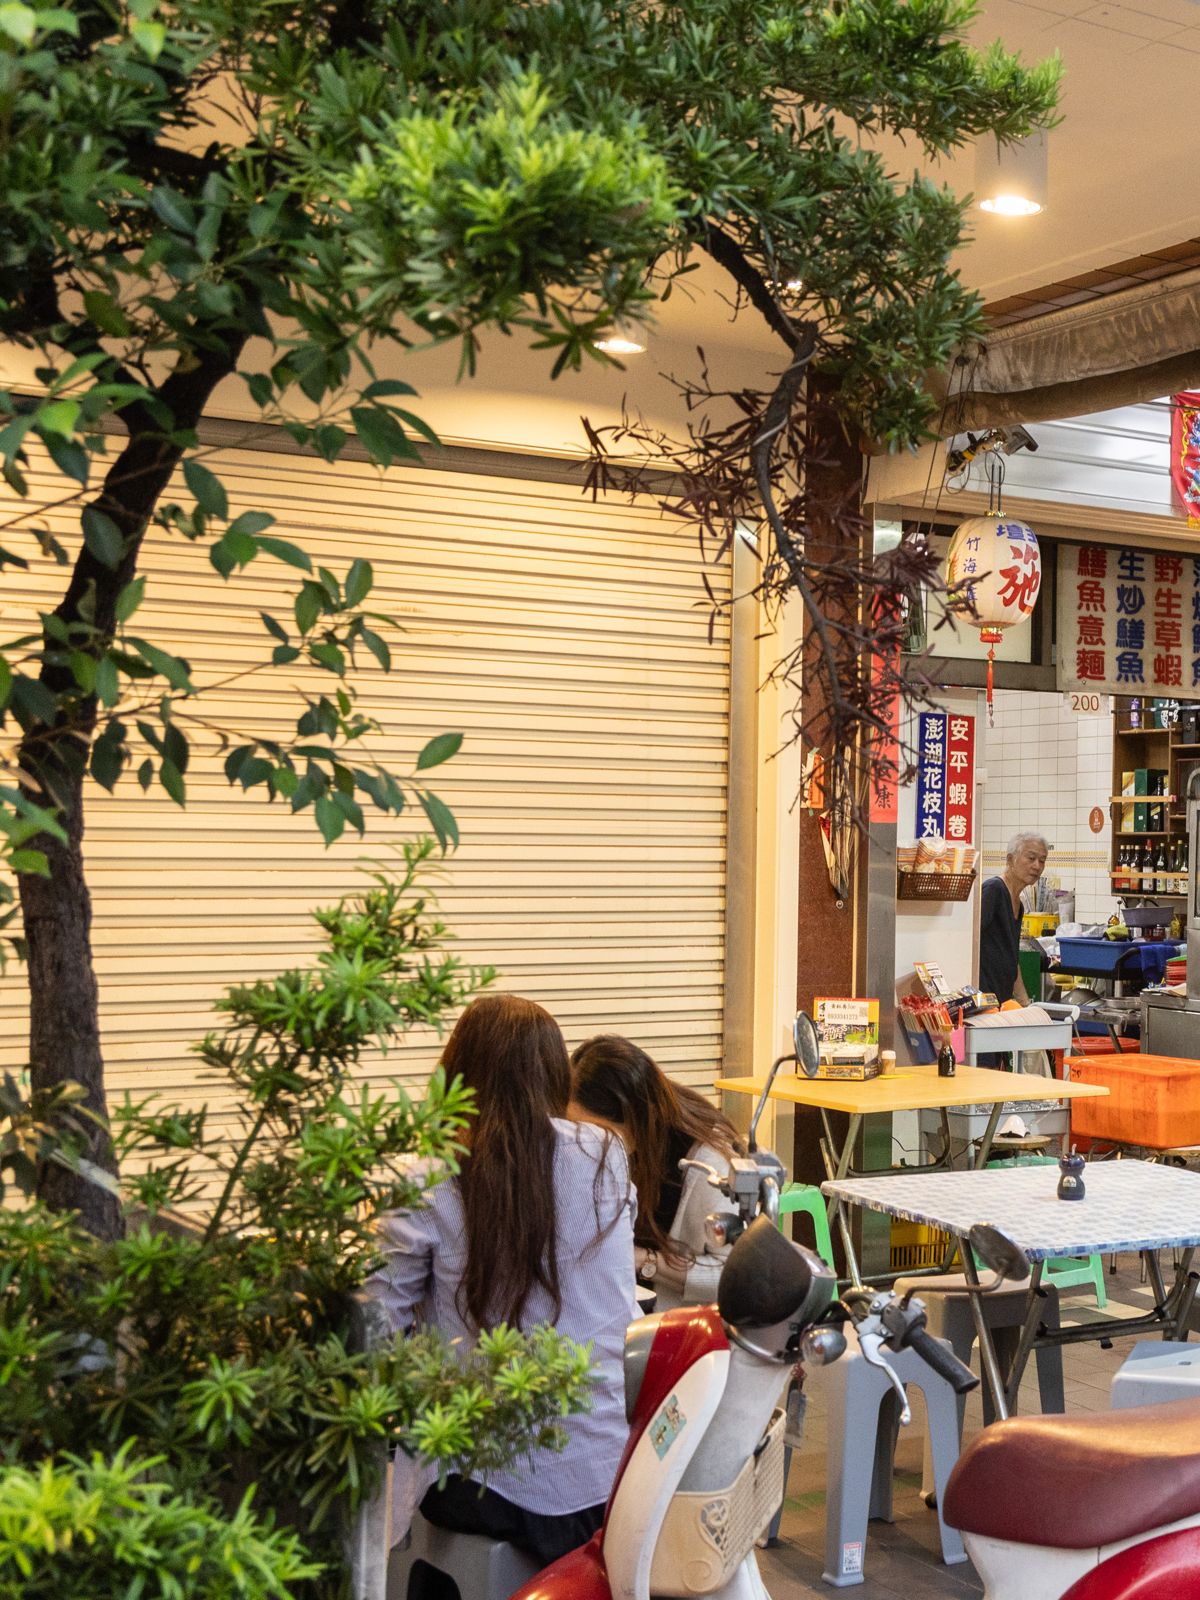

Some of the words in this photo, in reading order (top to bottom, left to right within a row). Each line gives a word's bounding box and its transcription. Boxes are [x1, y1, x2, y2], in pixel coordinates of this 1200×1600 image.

[1076, 549, 1107, 681] 鱔魚意麵
[1115, 551, 1145, 683] 生炒鱔魚
[1153, 554, 1183, 687] 野生草蝦
[1072, 695, 1099, 711] 200
[922, 717, 943, 837] 澎湖花枝丸
[948, 719, 969, 837] 安平蝦卷
